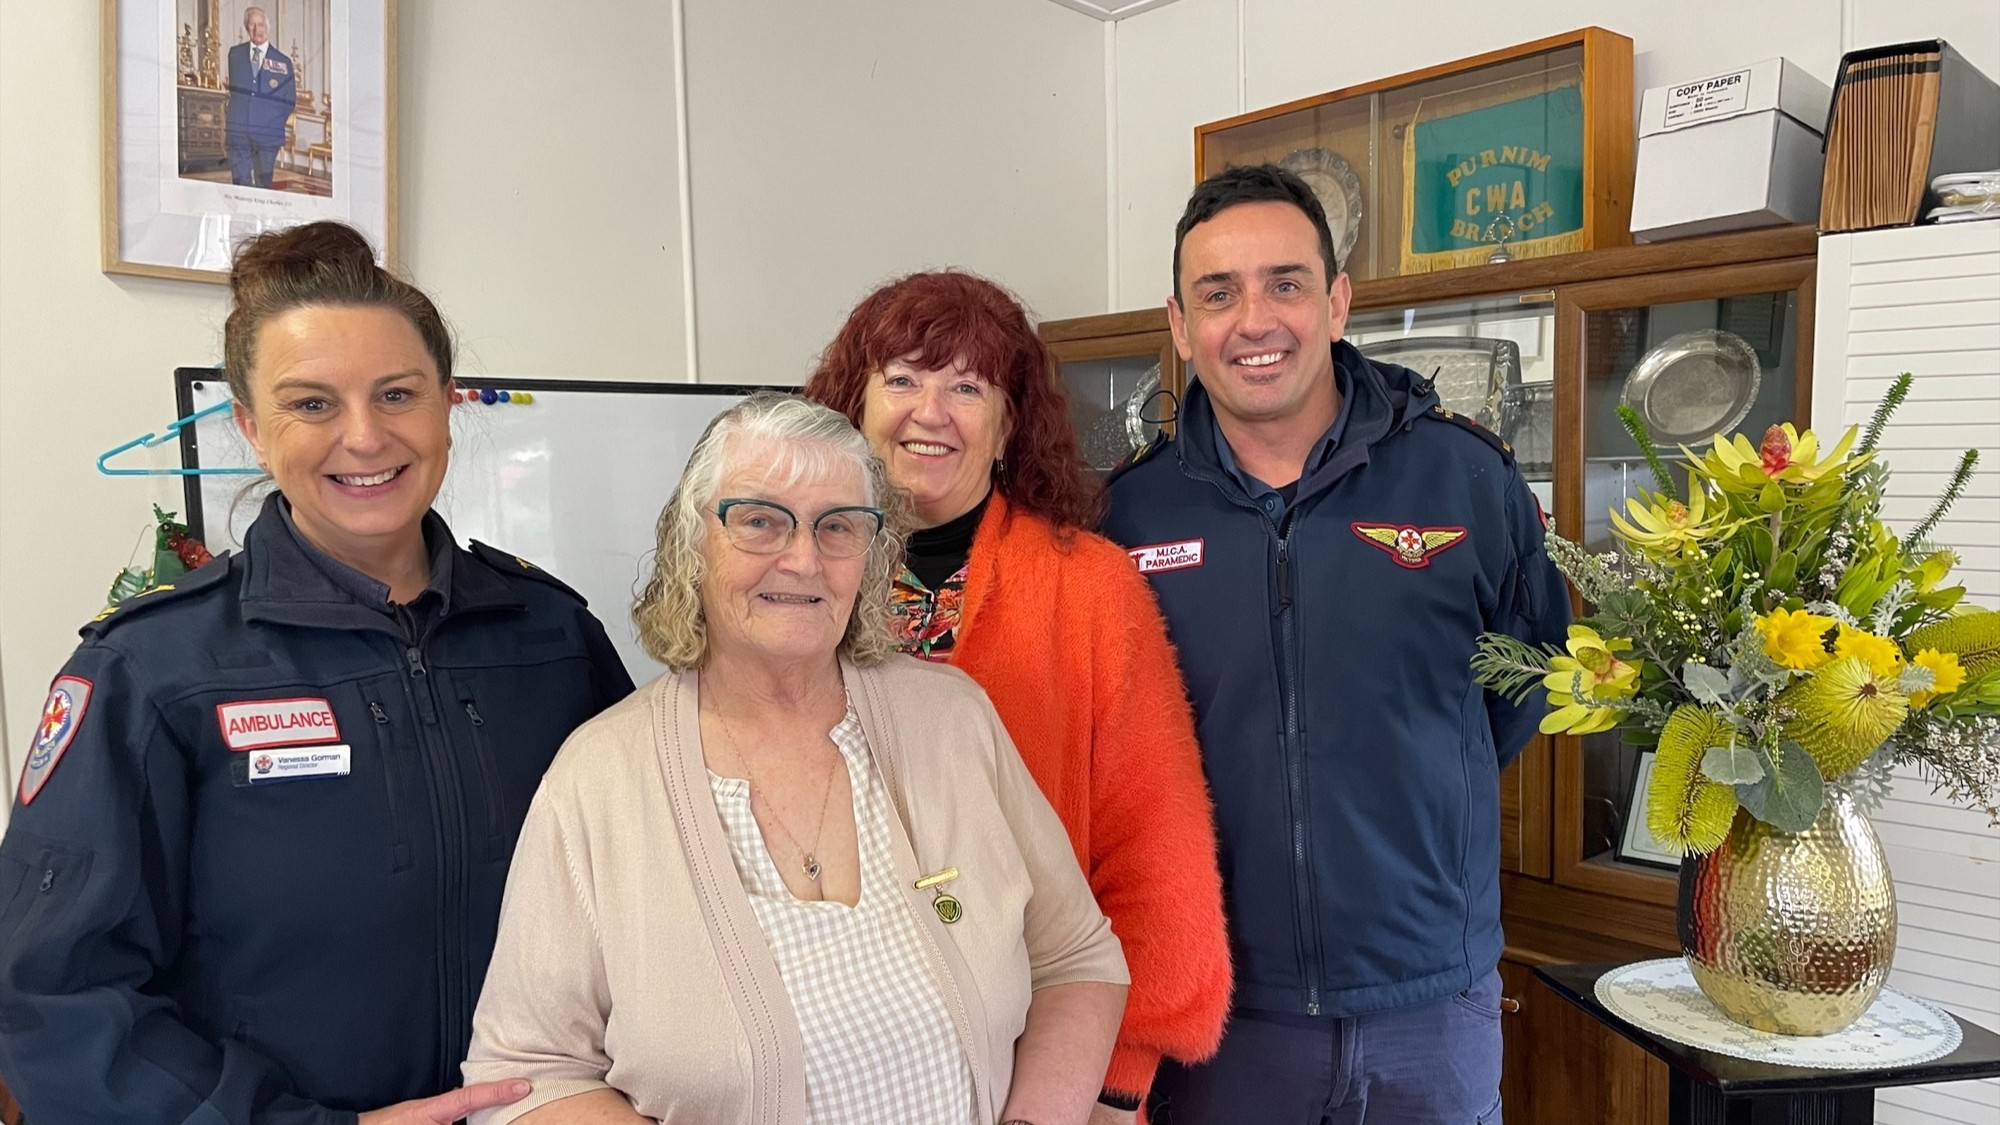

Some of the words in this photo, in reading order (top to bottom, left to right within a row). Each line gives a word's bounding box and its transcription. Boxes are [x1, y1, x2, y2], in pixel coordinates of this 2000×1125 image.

[1676, 84, 1704, 97] COPY
[1706, 75, 1741, 90] PAPER
[1446, 146, 1551, 188] PURNIM
[1466, 180, 1526, 216] CWA
[1156, 545, 1188, 558] M.I.C.A.
[1146, 554, 1198, 569] PARAMEDIC
[229, 711, 333, 735] AMBULANCE
[277, 756, 310, 764] Vanessa
[311, 754, 341, 762] Gorman
[277, 763, 299, 771] Regional
[299, 762, 318, 770] Director
